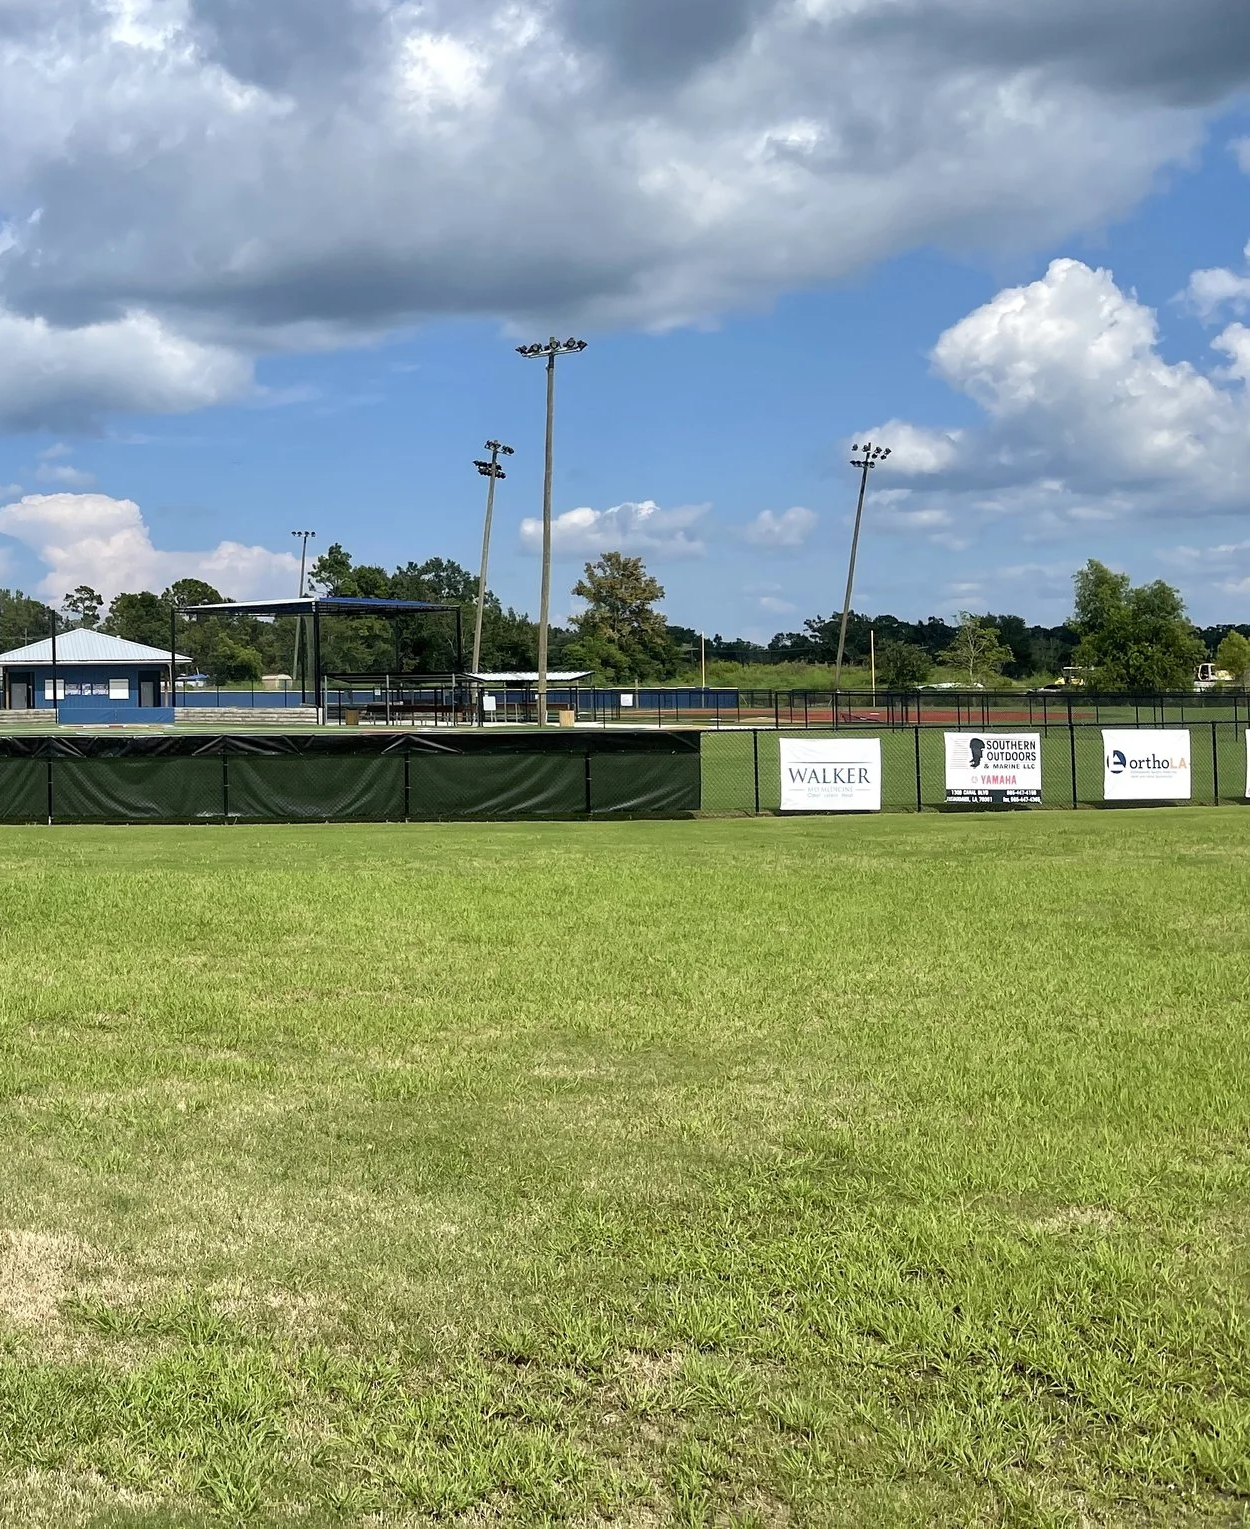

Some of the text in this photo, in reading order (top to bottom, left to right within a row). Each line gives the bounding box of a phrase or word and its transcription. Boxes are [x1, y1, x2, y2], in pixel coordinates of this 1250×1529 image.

[986, 740, 1036, 751] SOUTHERN
[986, 751, 1037, 761] OUTDOORS
[1129, 753, 1187, 769] orthoLA
[788, 767, 871, 784] WALKER
[980, 774, 1017, 785] YAMAHA
